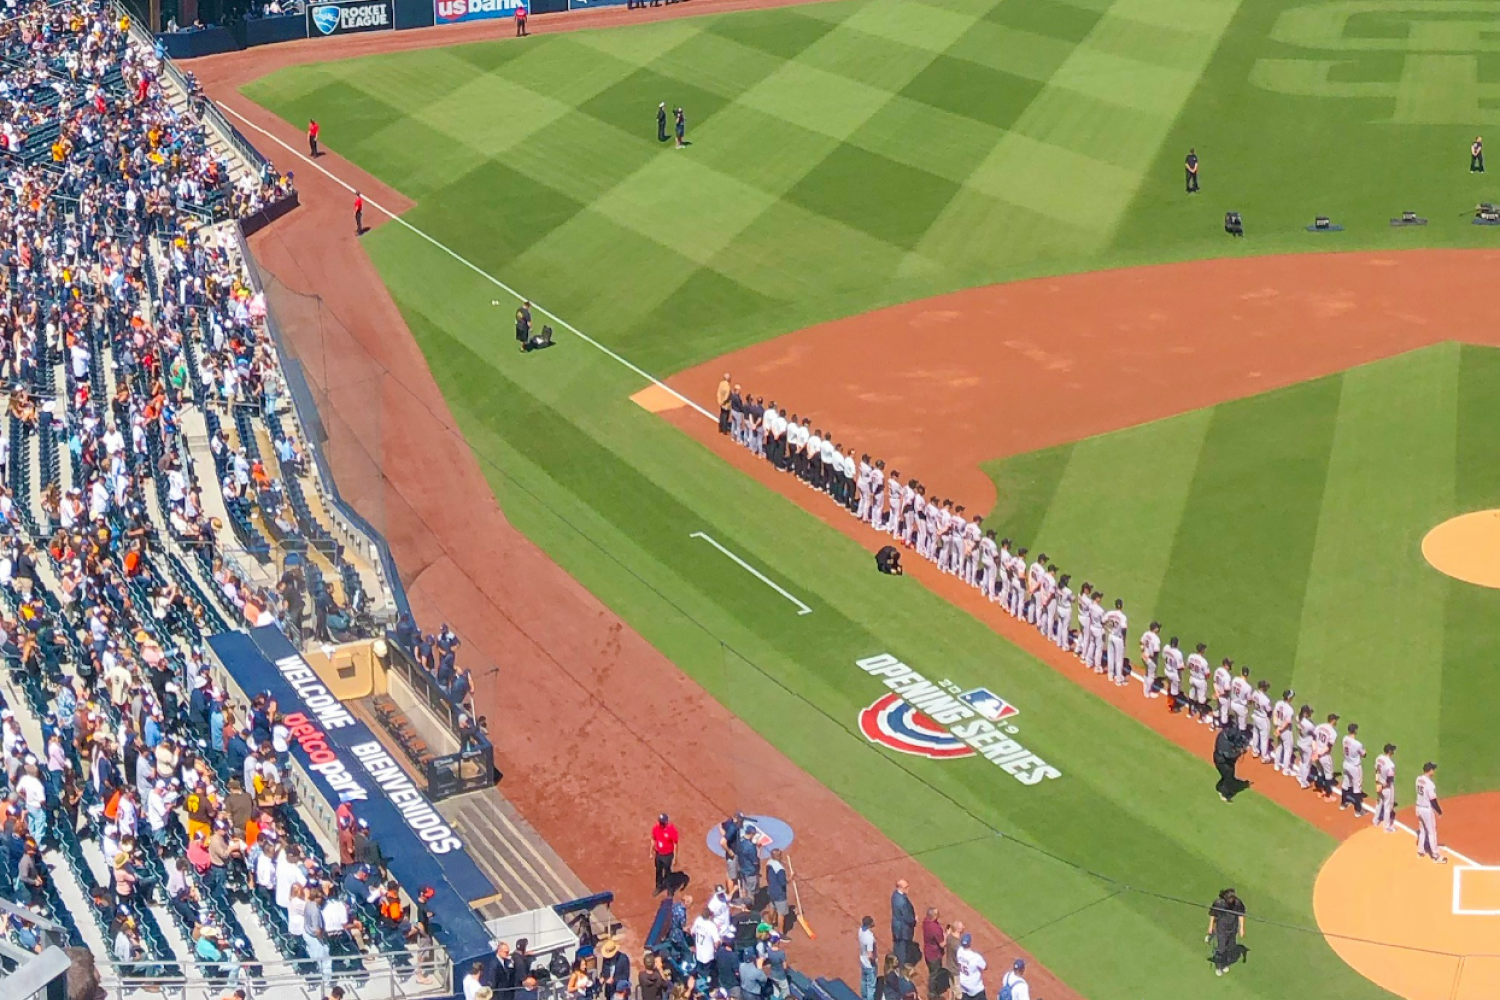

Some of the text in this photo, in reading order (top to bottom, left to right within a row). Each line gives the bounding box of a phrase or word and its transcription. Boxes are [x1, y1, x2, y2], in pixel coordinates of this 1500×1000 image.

[341, 4, 387, 19] ROCKET
[341, 14, 388, 29] LEAGUE
[275, 654, 355, 730] WELCOME
[855, 653, 1062, 785] OPENING SERIES
[351, 740, 462, 854] BIENVENIDOS
[696, 932, 705, 945] 17
